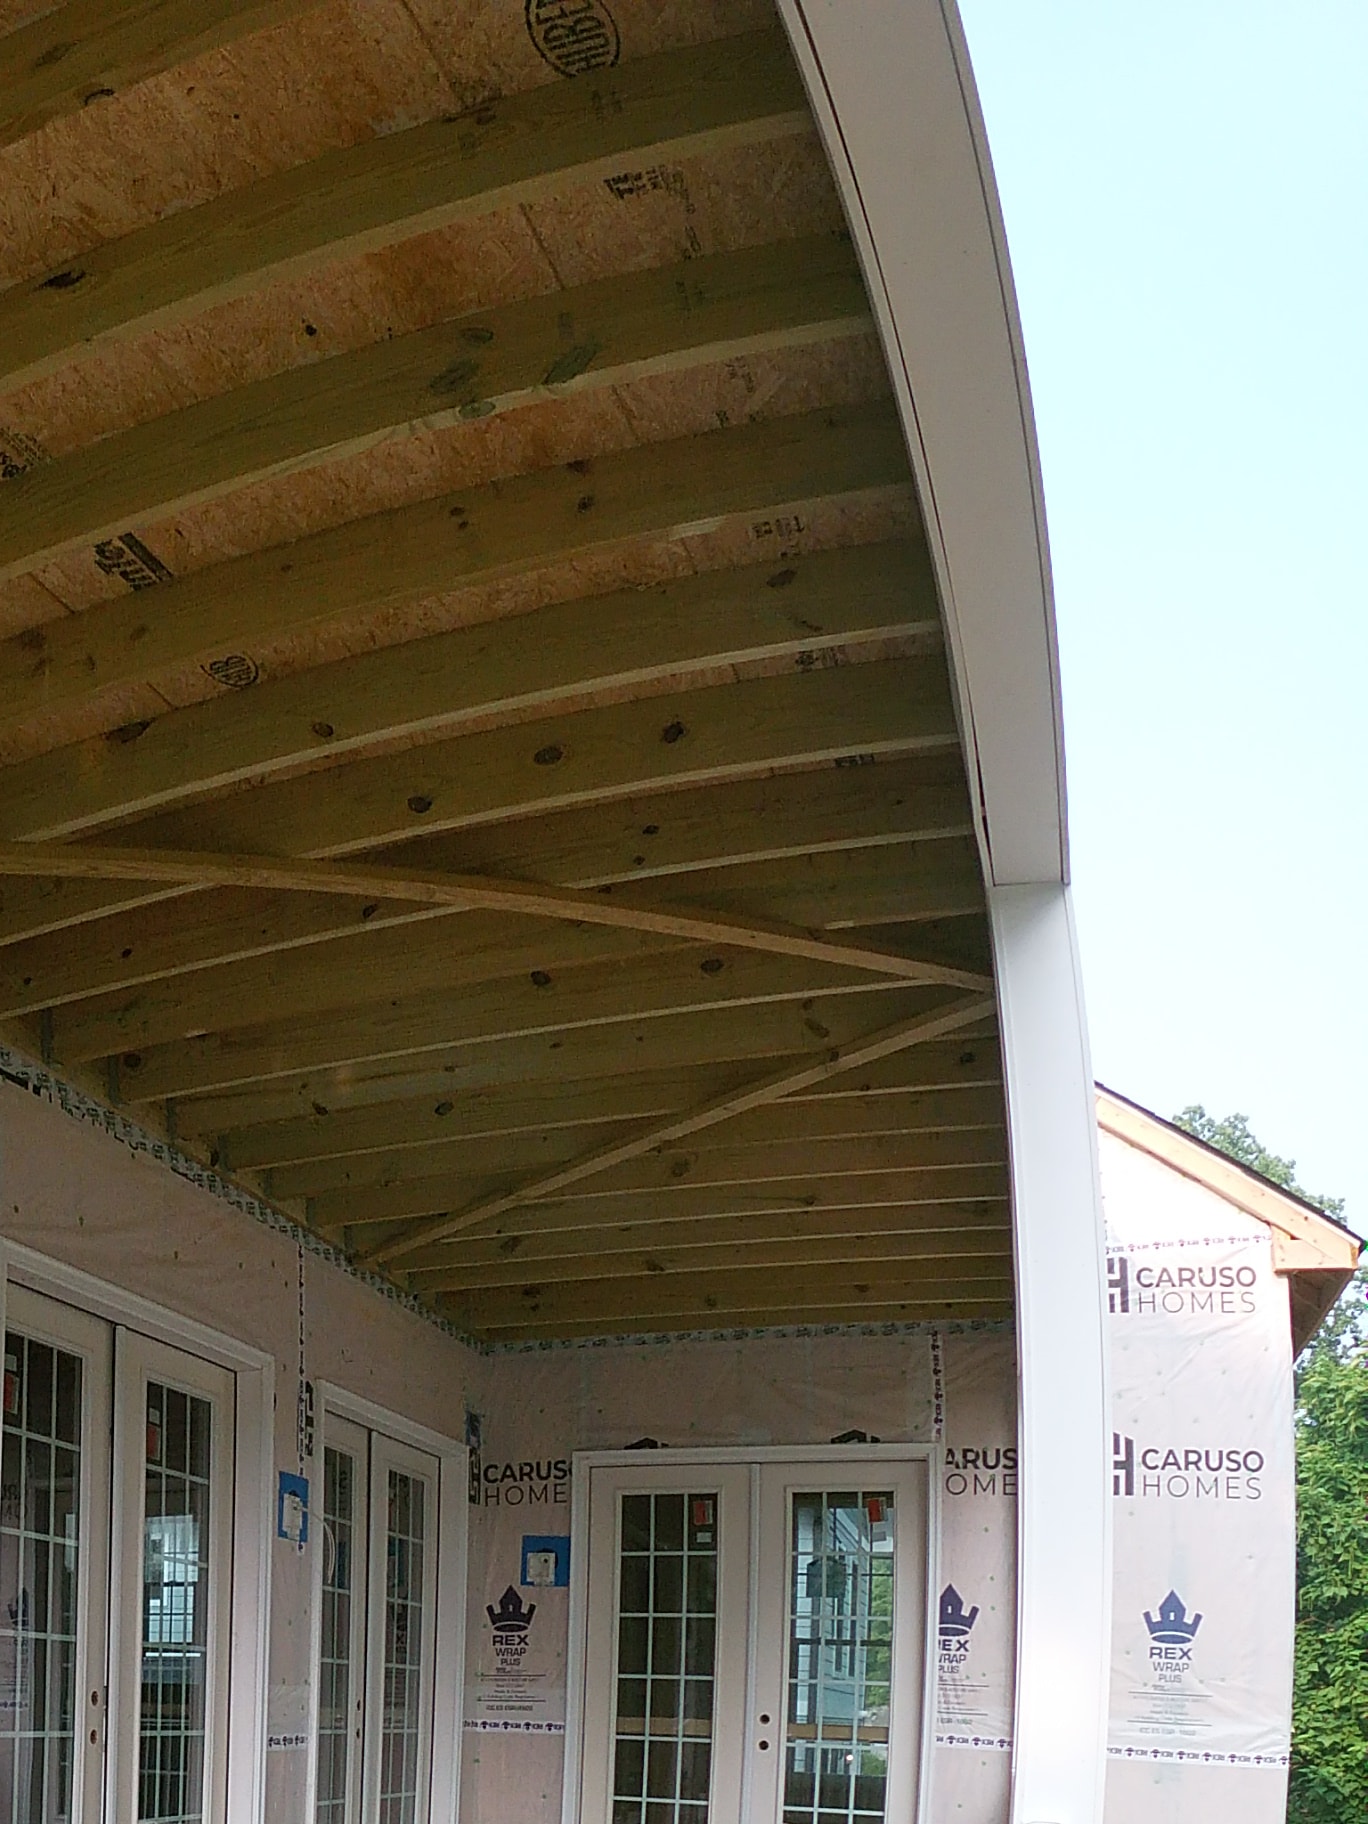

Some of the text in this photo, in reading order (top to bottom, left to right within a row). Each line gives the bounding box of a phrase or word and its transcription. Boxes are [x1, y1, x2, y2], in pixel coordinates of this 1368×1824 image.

[1136, 1266, 1257, 1288] CARUSO
[1138, 1291, 1257, 1314] HOMES
[945, 1448, 1017, 1470] ARUS
[1141, 1448, 1264, 1473] CARUSO
[483, 1460, 572, 1484] CARUS
[485, 1483, 567, 1507] HOME
[945, 1473, 1017, 1496] OME
[1143, 1474, 1262, 1500] HOMES
[492, 1634, 530, 1647] REX
[495, 1647, 527, 1657] WRAP
[1149, 1646, 1192, 1661] REX
[1152, 1661, 1190, 1673] WRAP
[1158, 1673, 1182, 1683] PLUS
